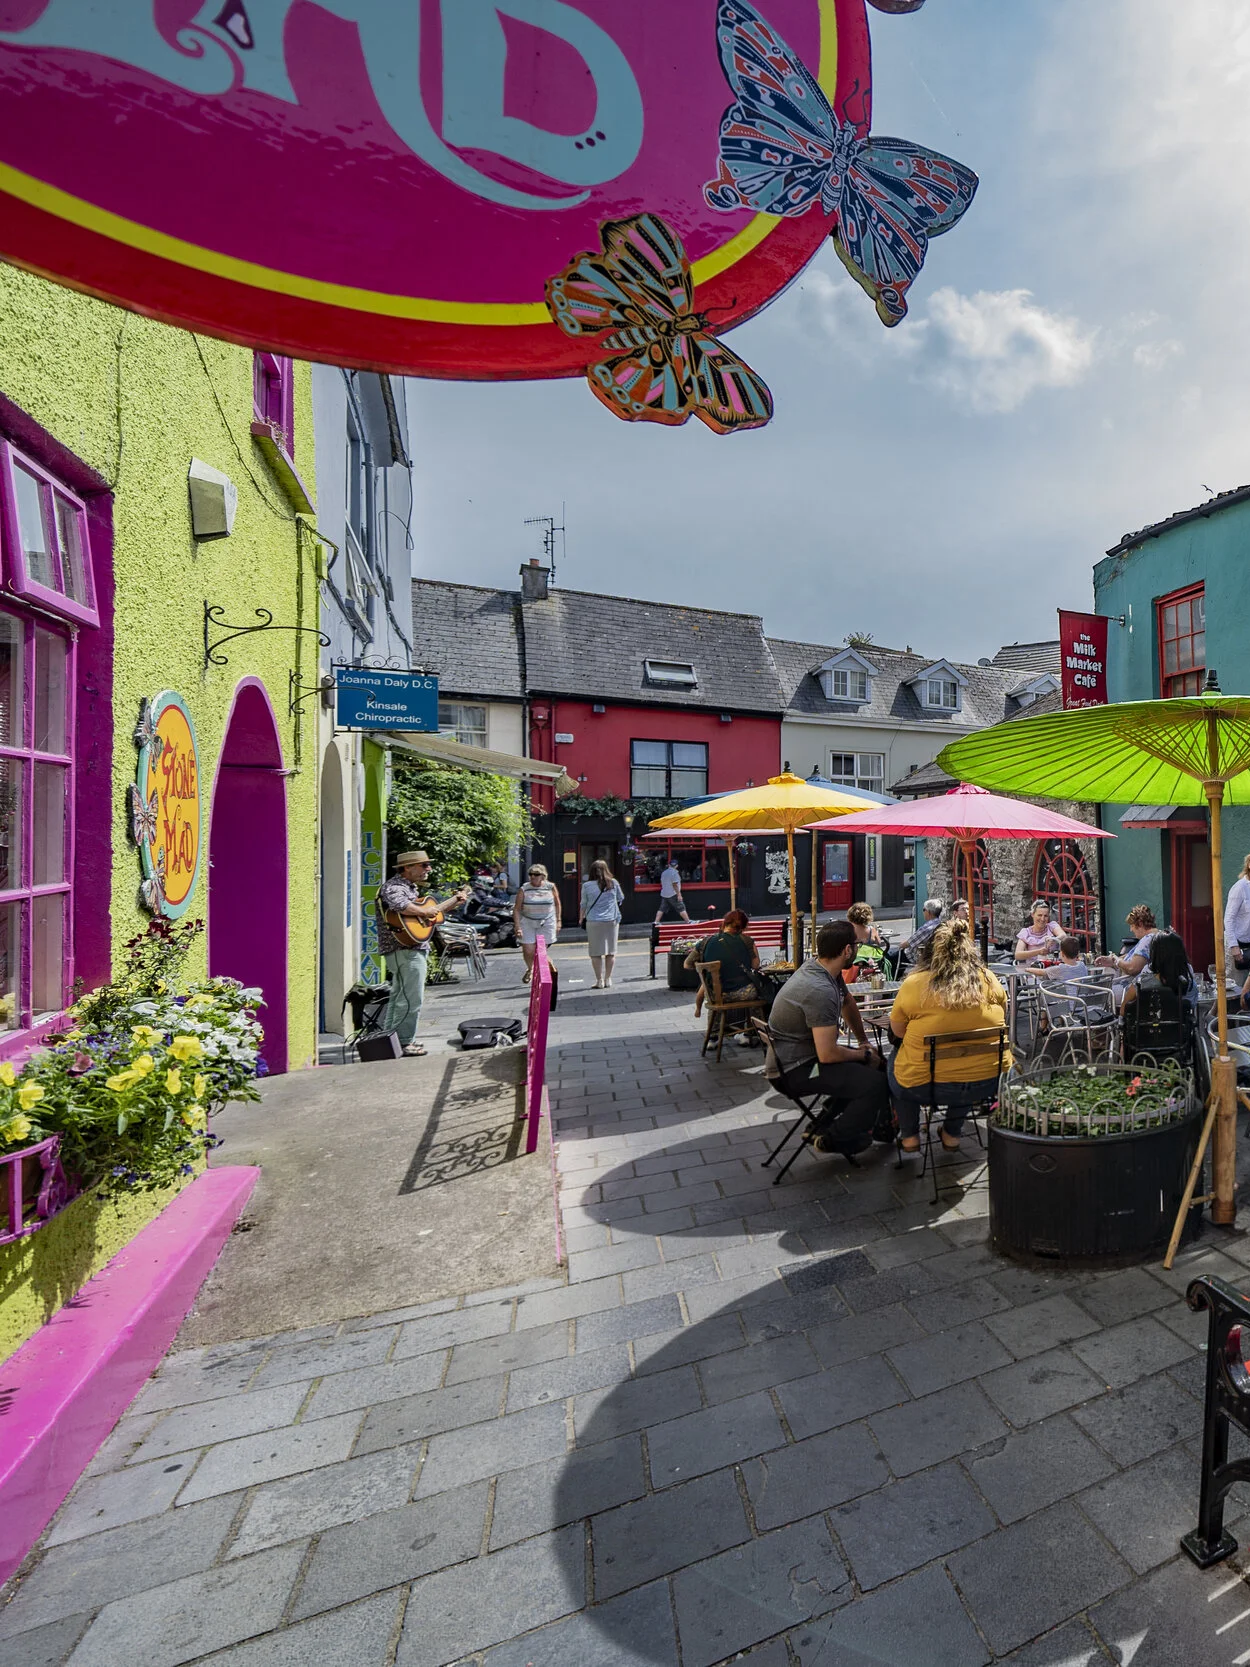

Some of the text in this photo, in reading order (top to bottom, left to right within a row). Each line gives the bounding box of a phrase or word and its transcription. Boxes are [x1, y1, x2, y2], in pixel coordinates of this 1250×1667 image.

[1080, 633, 1091, 641] the
[1073, 642, 1097, 657] Milk
[1066, 656, 1103, 673] Market
[339, 675, 436, 690] Joanna Daly D.C.
[1074, 673, 1097, 688] Café
[366, 700, 408, 711] Kinsale
[355, 711, 422, 724] Chiropractic
[163, 804, 194, 878] MAD
[361, 832, 382, 886] ICE
[360, 900, 381, 985] CREAM
